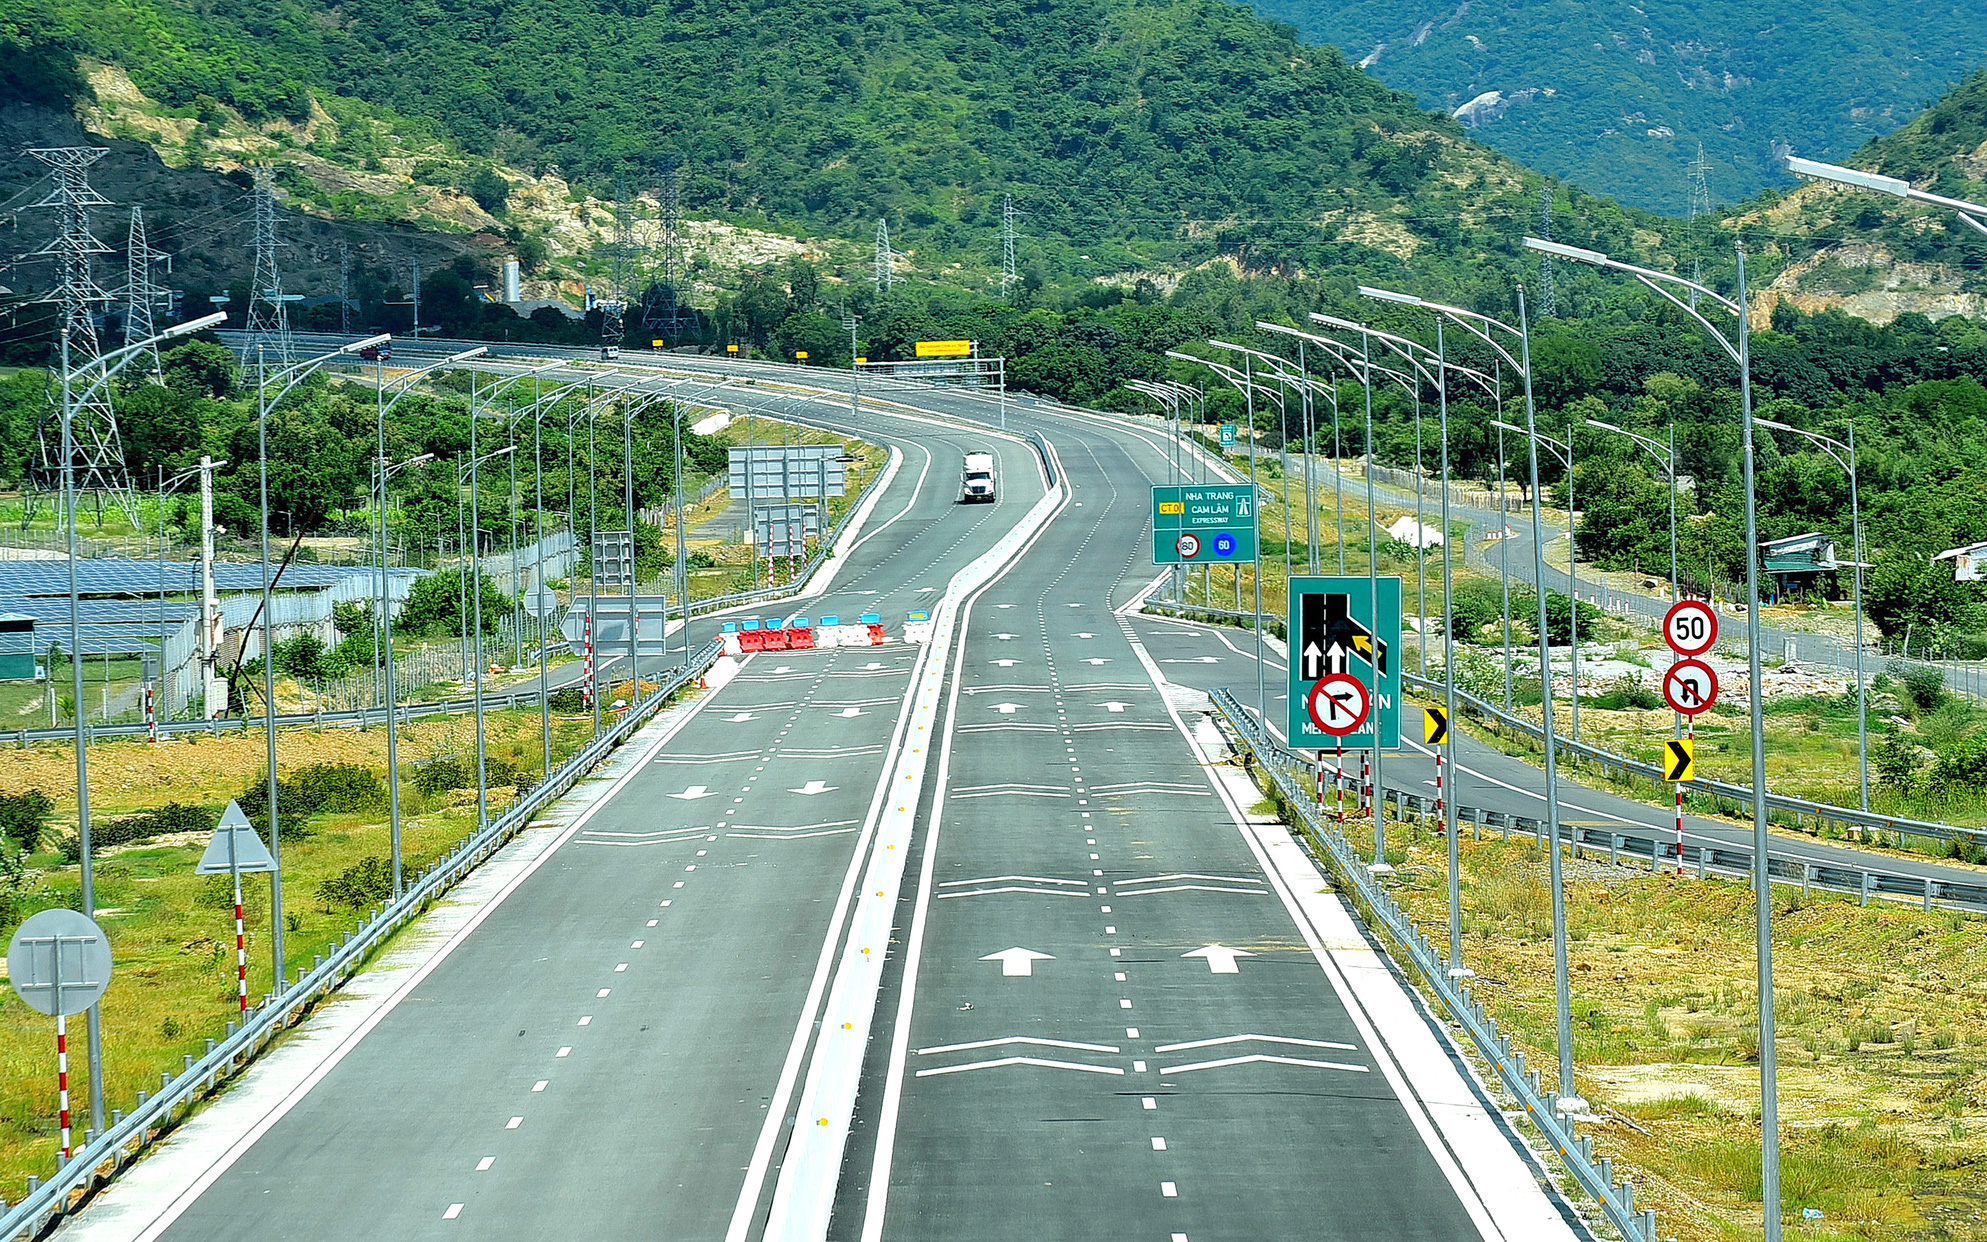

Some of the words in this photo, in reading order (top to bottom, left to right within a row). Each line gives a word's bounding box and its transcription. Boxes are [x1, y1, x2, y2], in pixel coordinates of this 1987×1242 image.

[1185, 492, 1203, 500] NHA
[1205, 491, 1234, 500] TRANG
[1161, 504, 1181, 512] CT.0
[1191, 505, 1210, 514] CAM
[1211, 503, 1229, 514] LÂM
[1218, 540, 1230, 550] 60
[1676, 616, 1704, 640] 50
